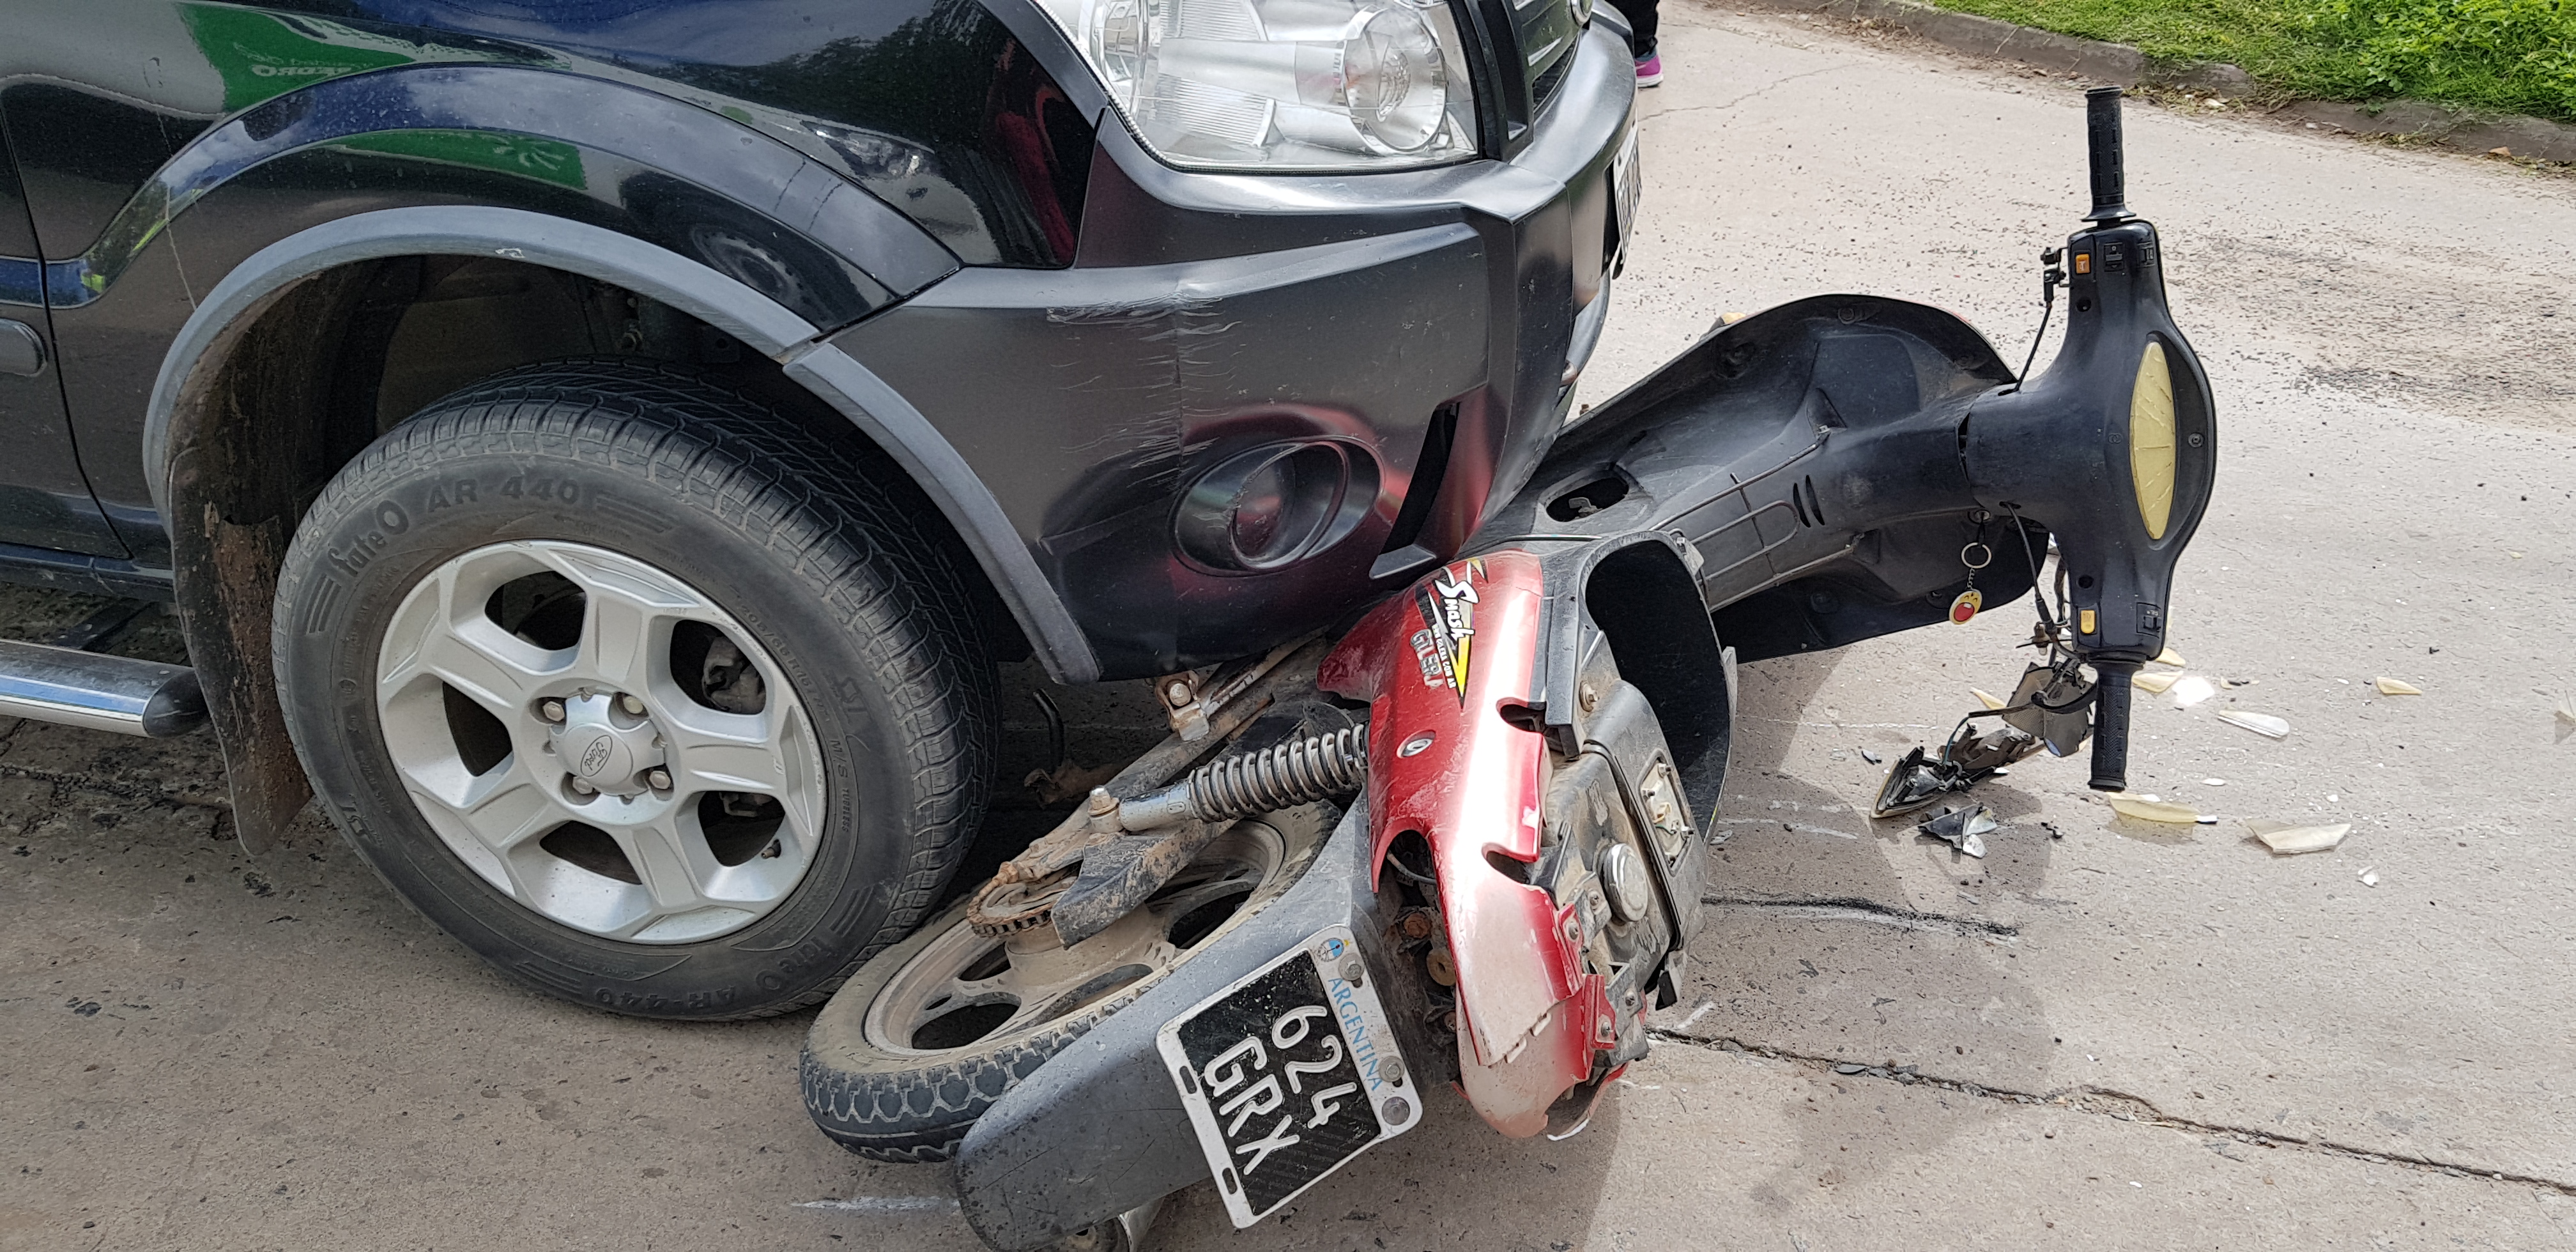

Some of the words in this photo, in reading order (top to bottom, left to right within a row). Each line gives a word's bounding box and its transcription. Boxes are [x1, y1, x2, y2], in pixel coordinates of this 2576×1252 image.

[428, 476, 580, 512] AR-440
[585, 742, 608, 771] Ford
[839, 788, 850, 833] TUBELESS
[1271, 1005, 1358, 1129] 624
[1328, 977, 1384, 1092] ARGENTINA
[1204, 1035, 1301, 1175] GRX
